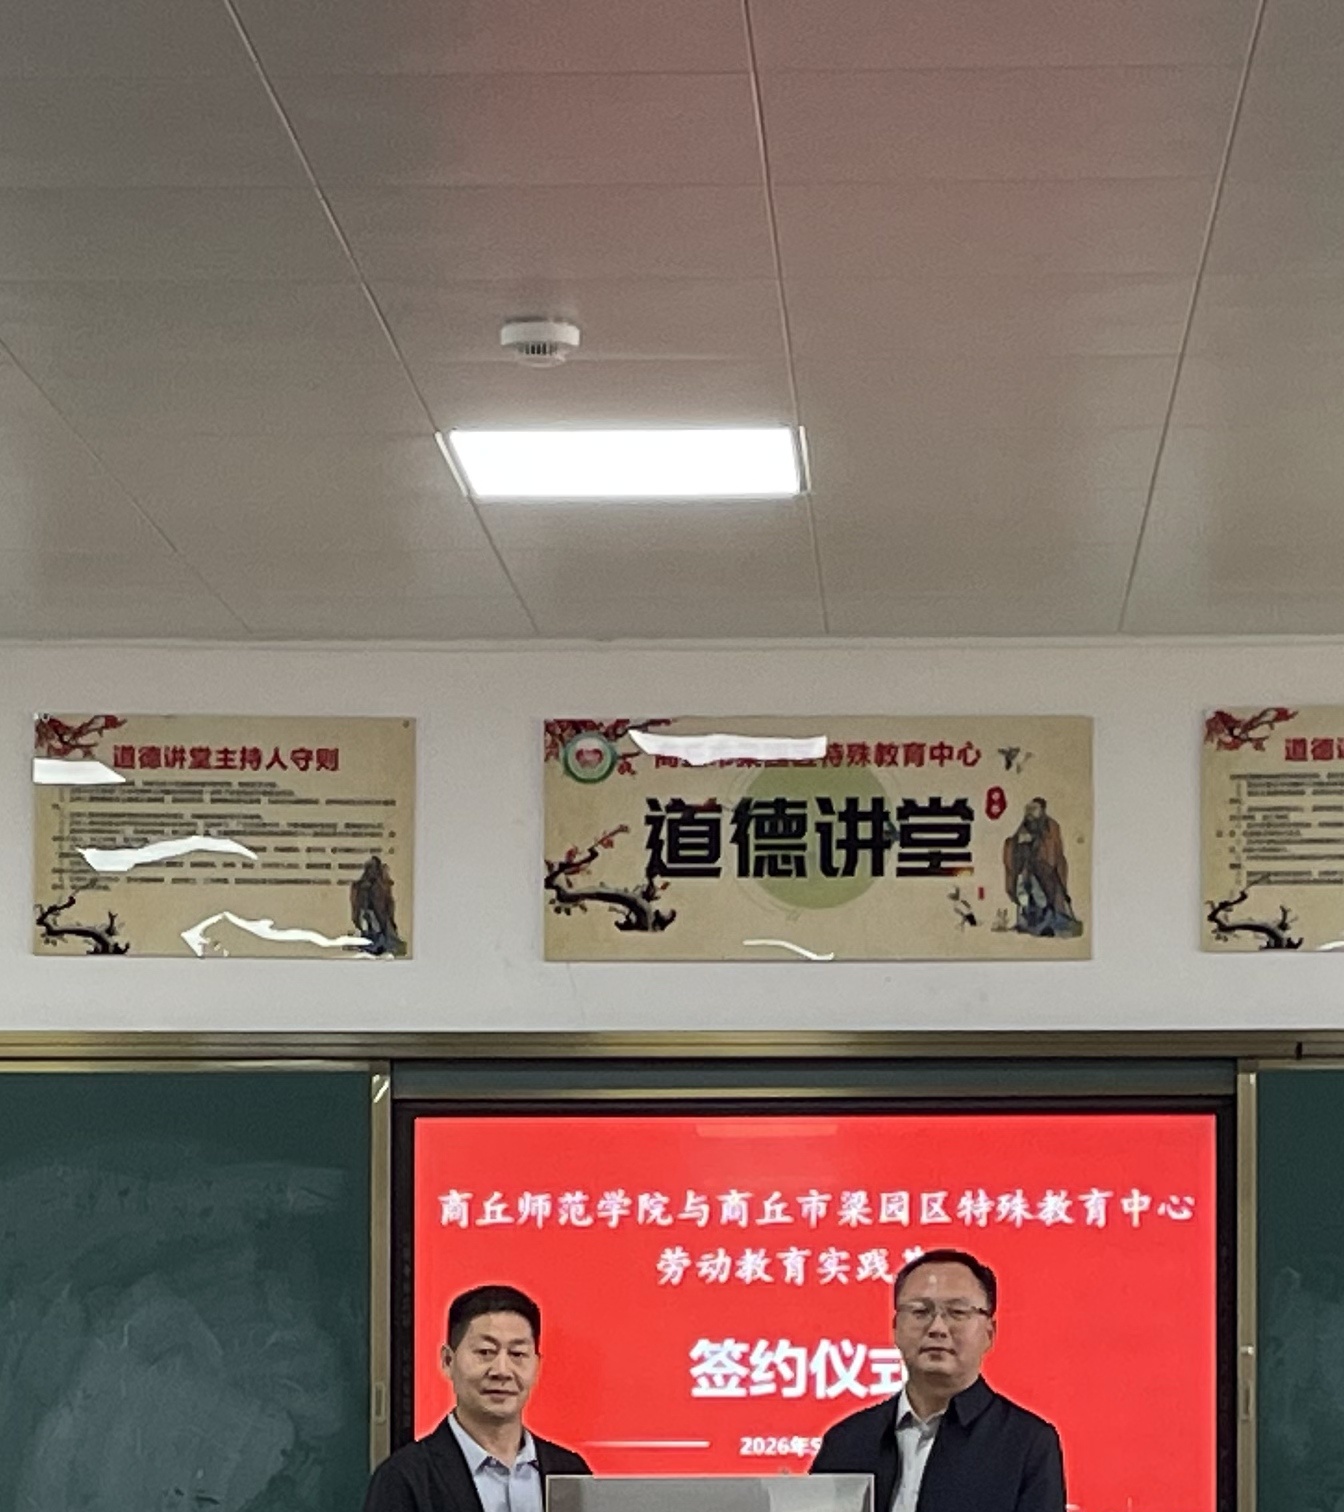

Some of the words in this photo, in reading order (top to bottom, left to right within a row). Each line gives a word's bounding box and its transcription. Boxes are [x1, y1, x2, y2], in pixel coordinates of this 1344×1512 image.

[113, 745, 340, 771] 道德讲堂主持人守则
[644, 796, 975, 878] 道德讲堂
[438, 1187, 1196, 1229] 商丘师范学院与商丘市梁园区特殊教育中心
[688, 1337, 908, 1400] 签约仪式
